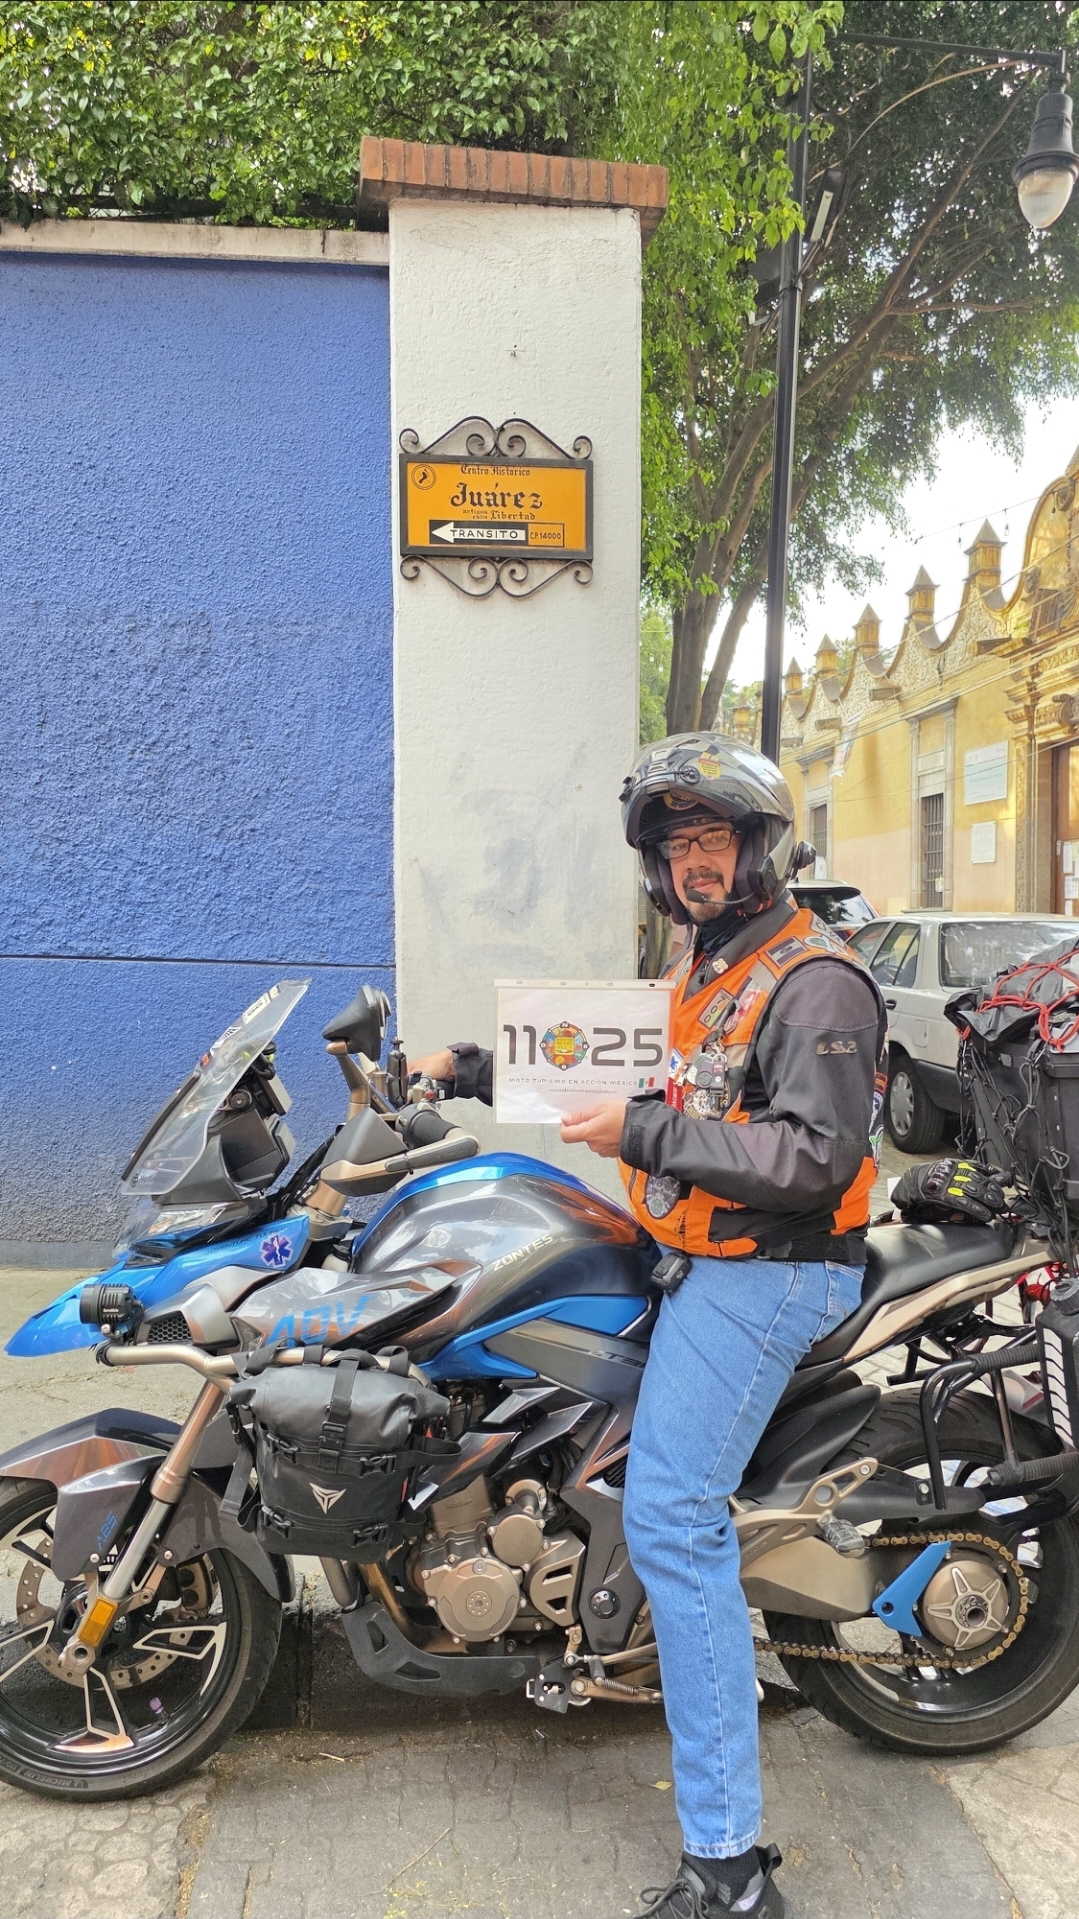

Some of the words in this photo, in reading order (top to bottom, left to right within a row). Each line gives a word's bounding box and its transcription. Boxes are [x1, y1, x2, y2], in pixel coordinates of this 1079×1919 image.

[460, 464, 489, 476] Centro
[450, 482, 543, 509] Juárez
[490, 509, 536, 520] Libertad
[450, 529, 518, 539] TRANSITO
[816, 1040, 858, 1055] LS2
[490, 1232, 554, 1272] ZONTES
[266, 1293, 378, 1348] ADV
[97, 1510, 117, 1551] ABS
[23, 1770, 72, 1787] MICHELIN
